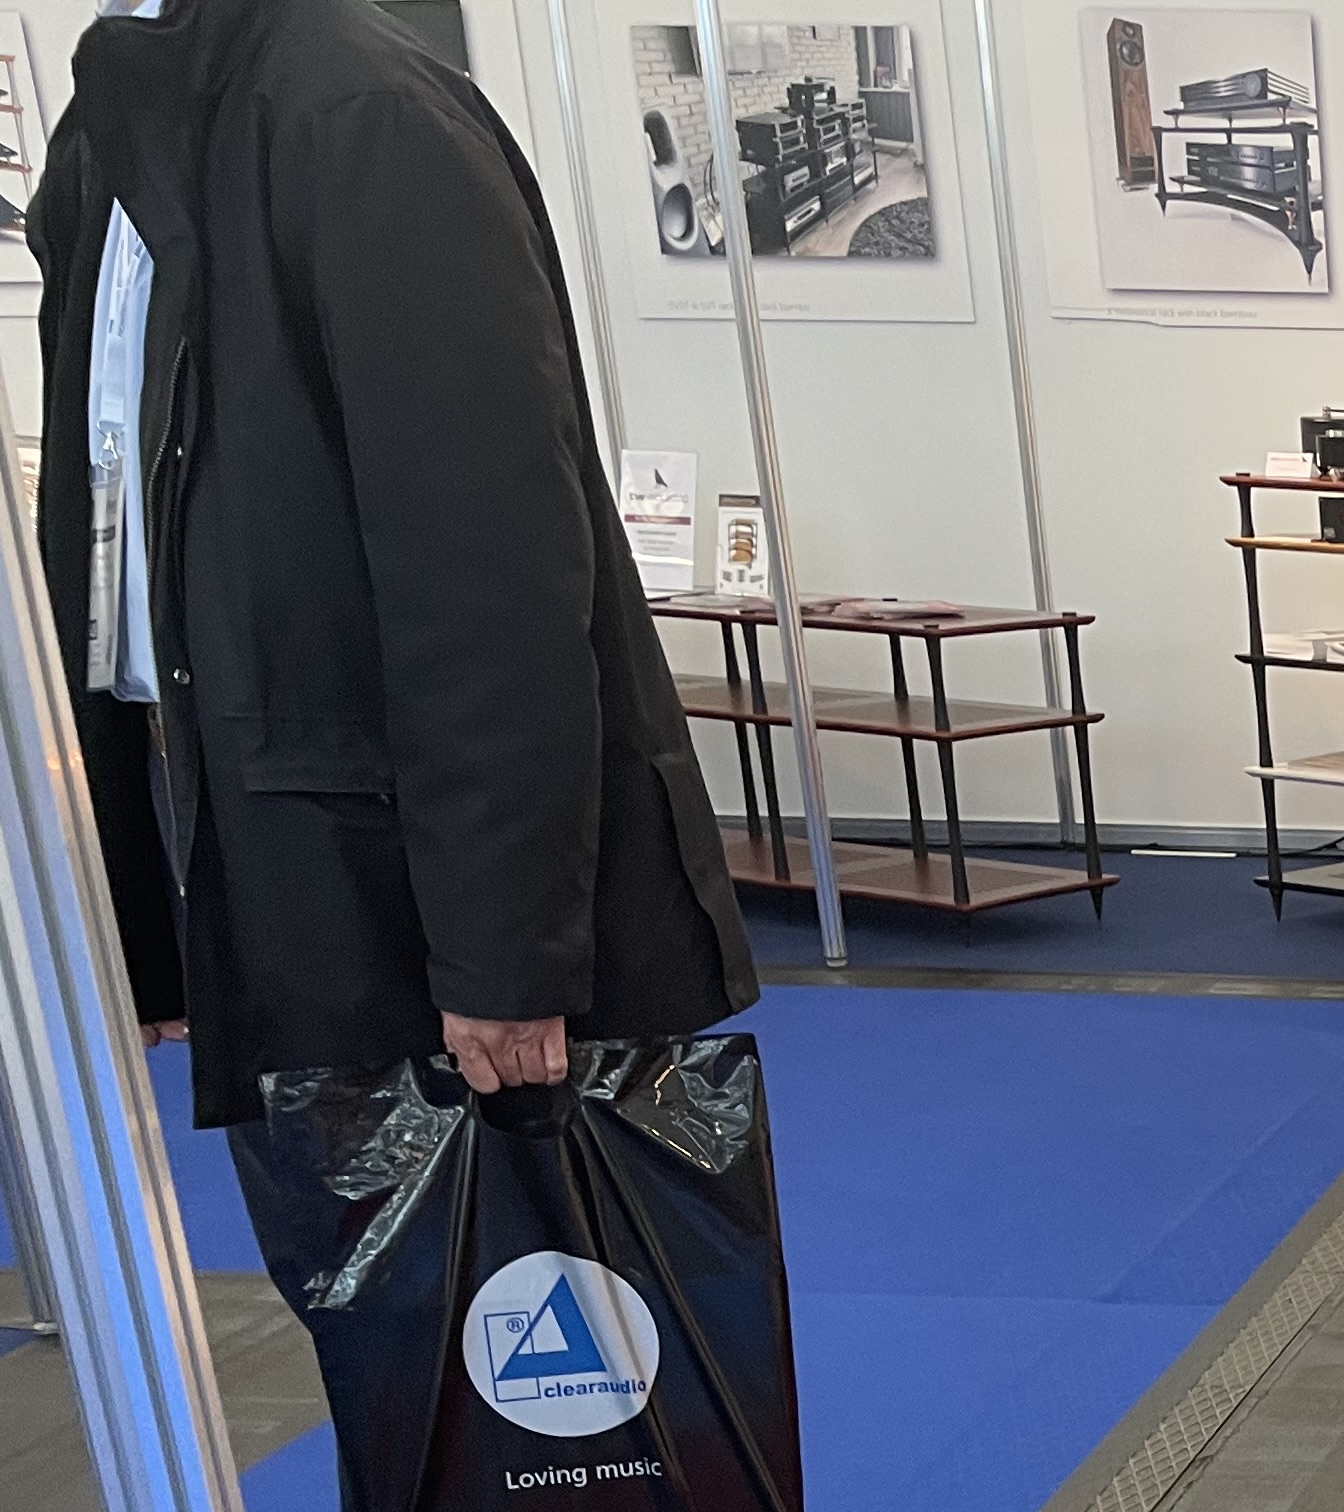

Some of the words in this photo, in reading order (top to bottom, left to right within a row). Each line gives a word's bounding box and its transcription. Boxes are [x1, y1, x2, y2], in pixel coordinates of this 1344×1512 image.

[543, 1380, 648, 1399] clearaudio
[505, 1463, 588, 1491] Loving
[596, 1456, 662, 1480] music
